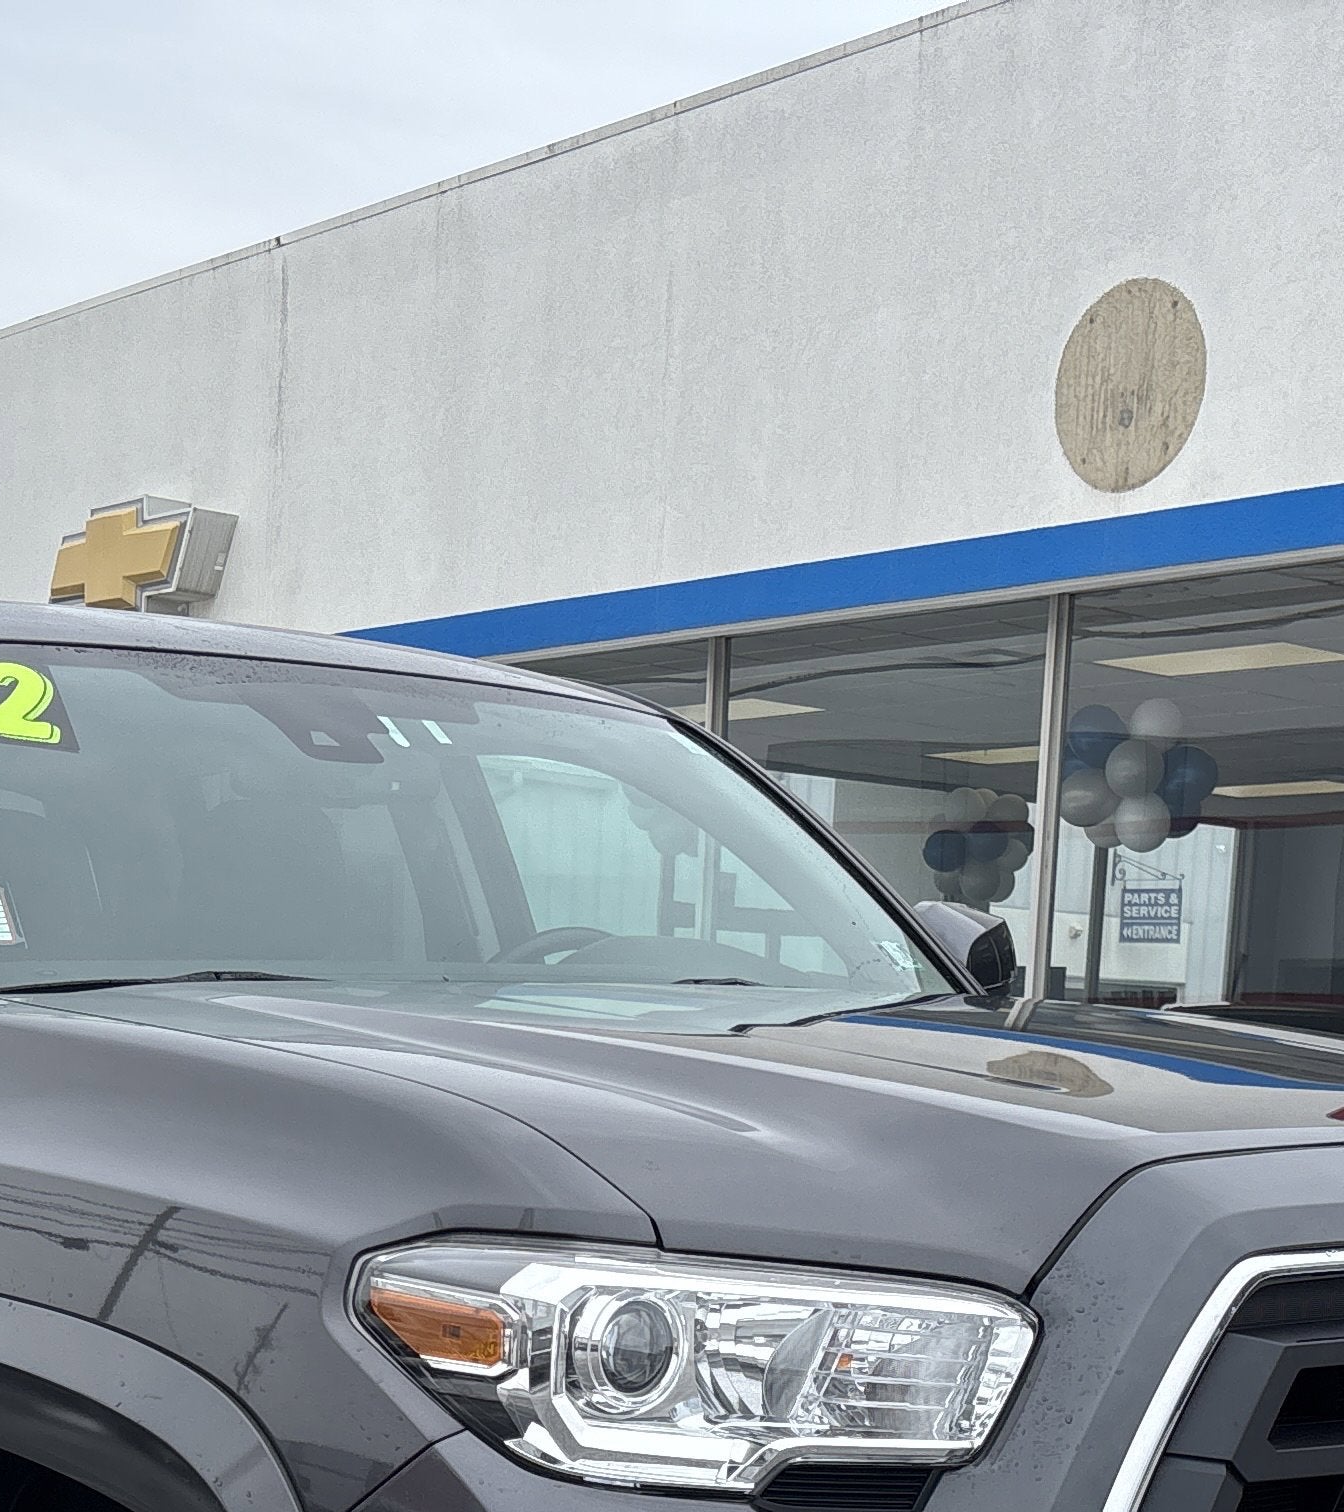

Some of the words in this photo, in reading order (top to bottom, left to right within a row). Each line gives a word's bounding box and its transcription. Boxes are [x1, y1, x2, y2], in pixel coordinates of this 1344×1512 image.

[1124, 893, 1166, 904] PARTS
[1169, 893, 1179, 904] &
[1123, 906, 1180, 918] SERVICE
[1132, 925, 1178, 939] ENTRANCE
